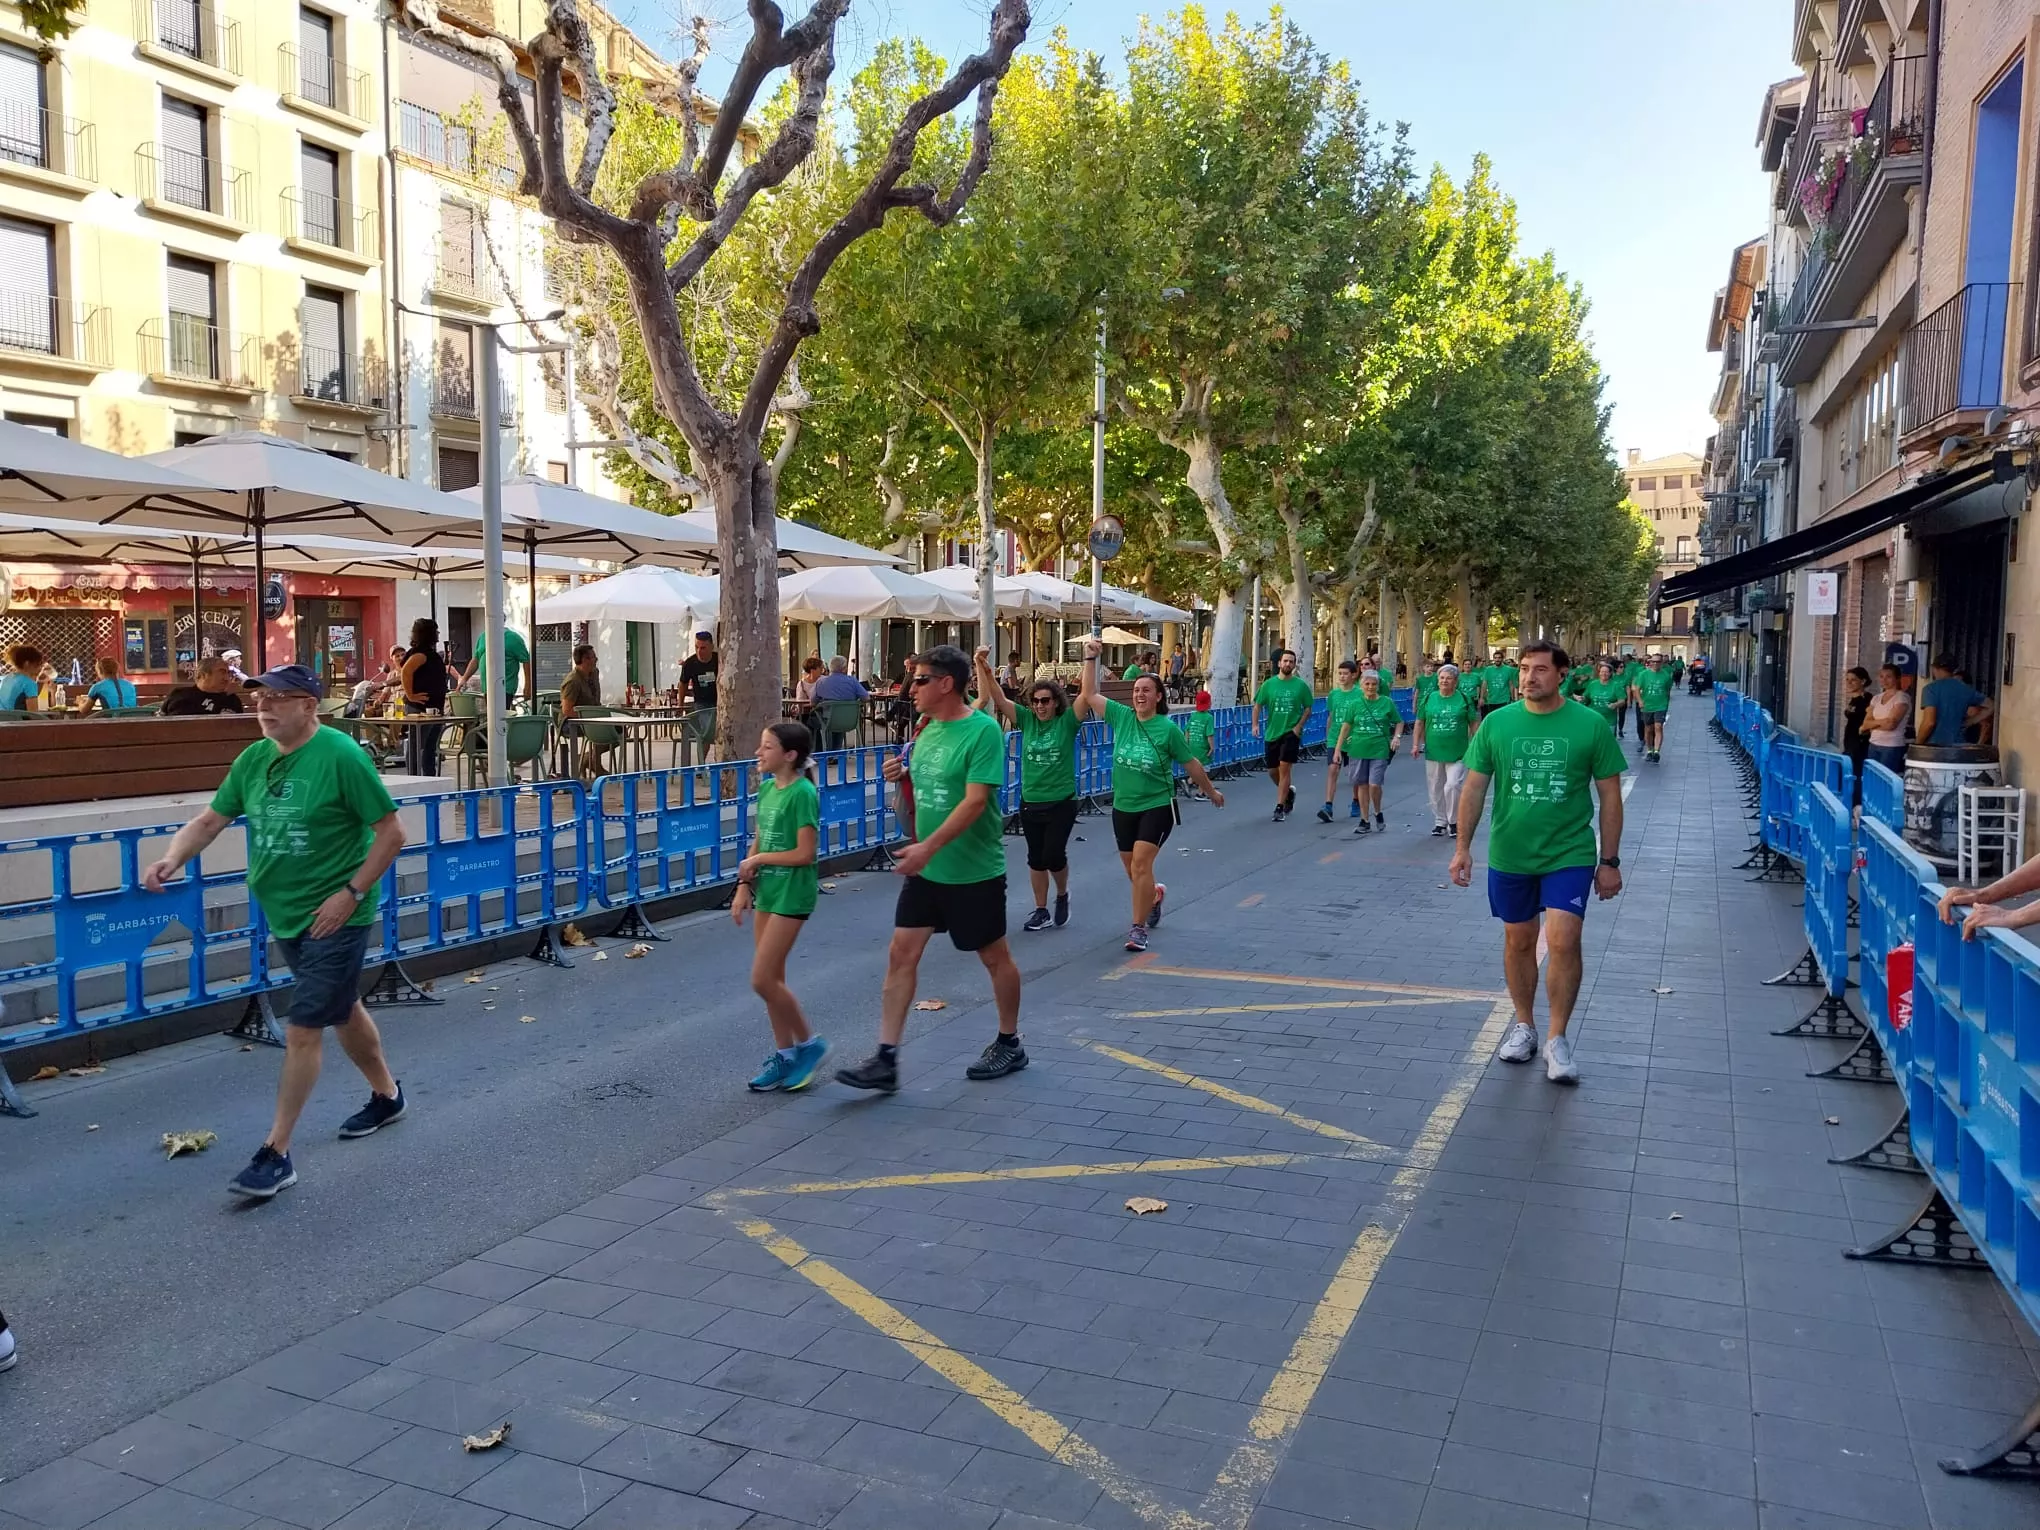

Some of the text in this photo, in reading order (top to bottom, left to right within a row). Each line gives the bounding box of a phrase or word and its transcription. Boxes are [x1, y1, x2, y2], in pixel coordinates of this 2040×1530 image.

[1893, 653, 1909, 666] P
[460, 859, 500, 872] BARBASTRO
[108, 914, 179, 932] BARBASTRO
